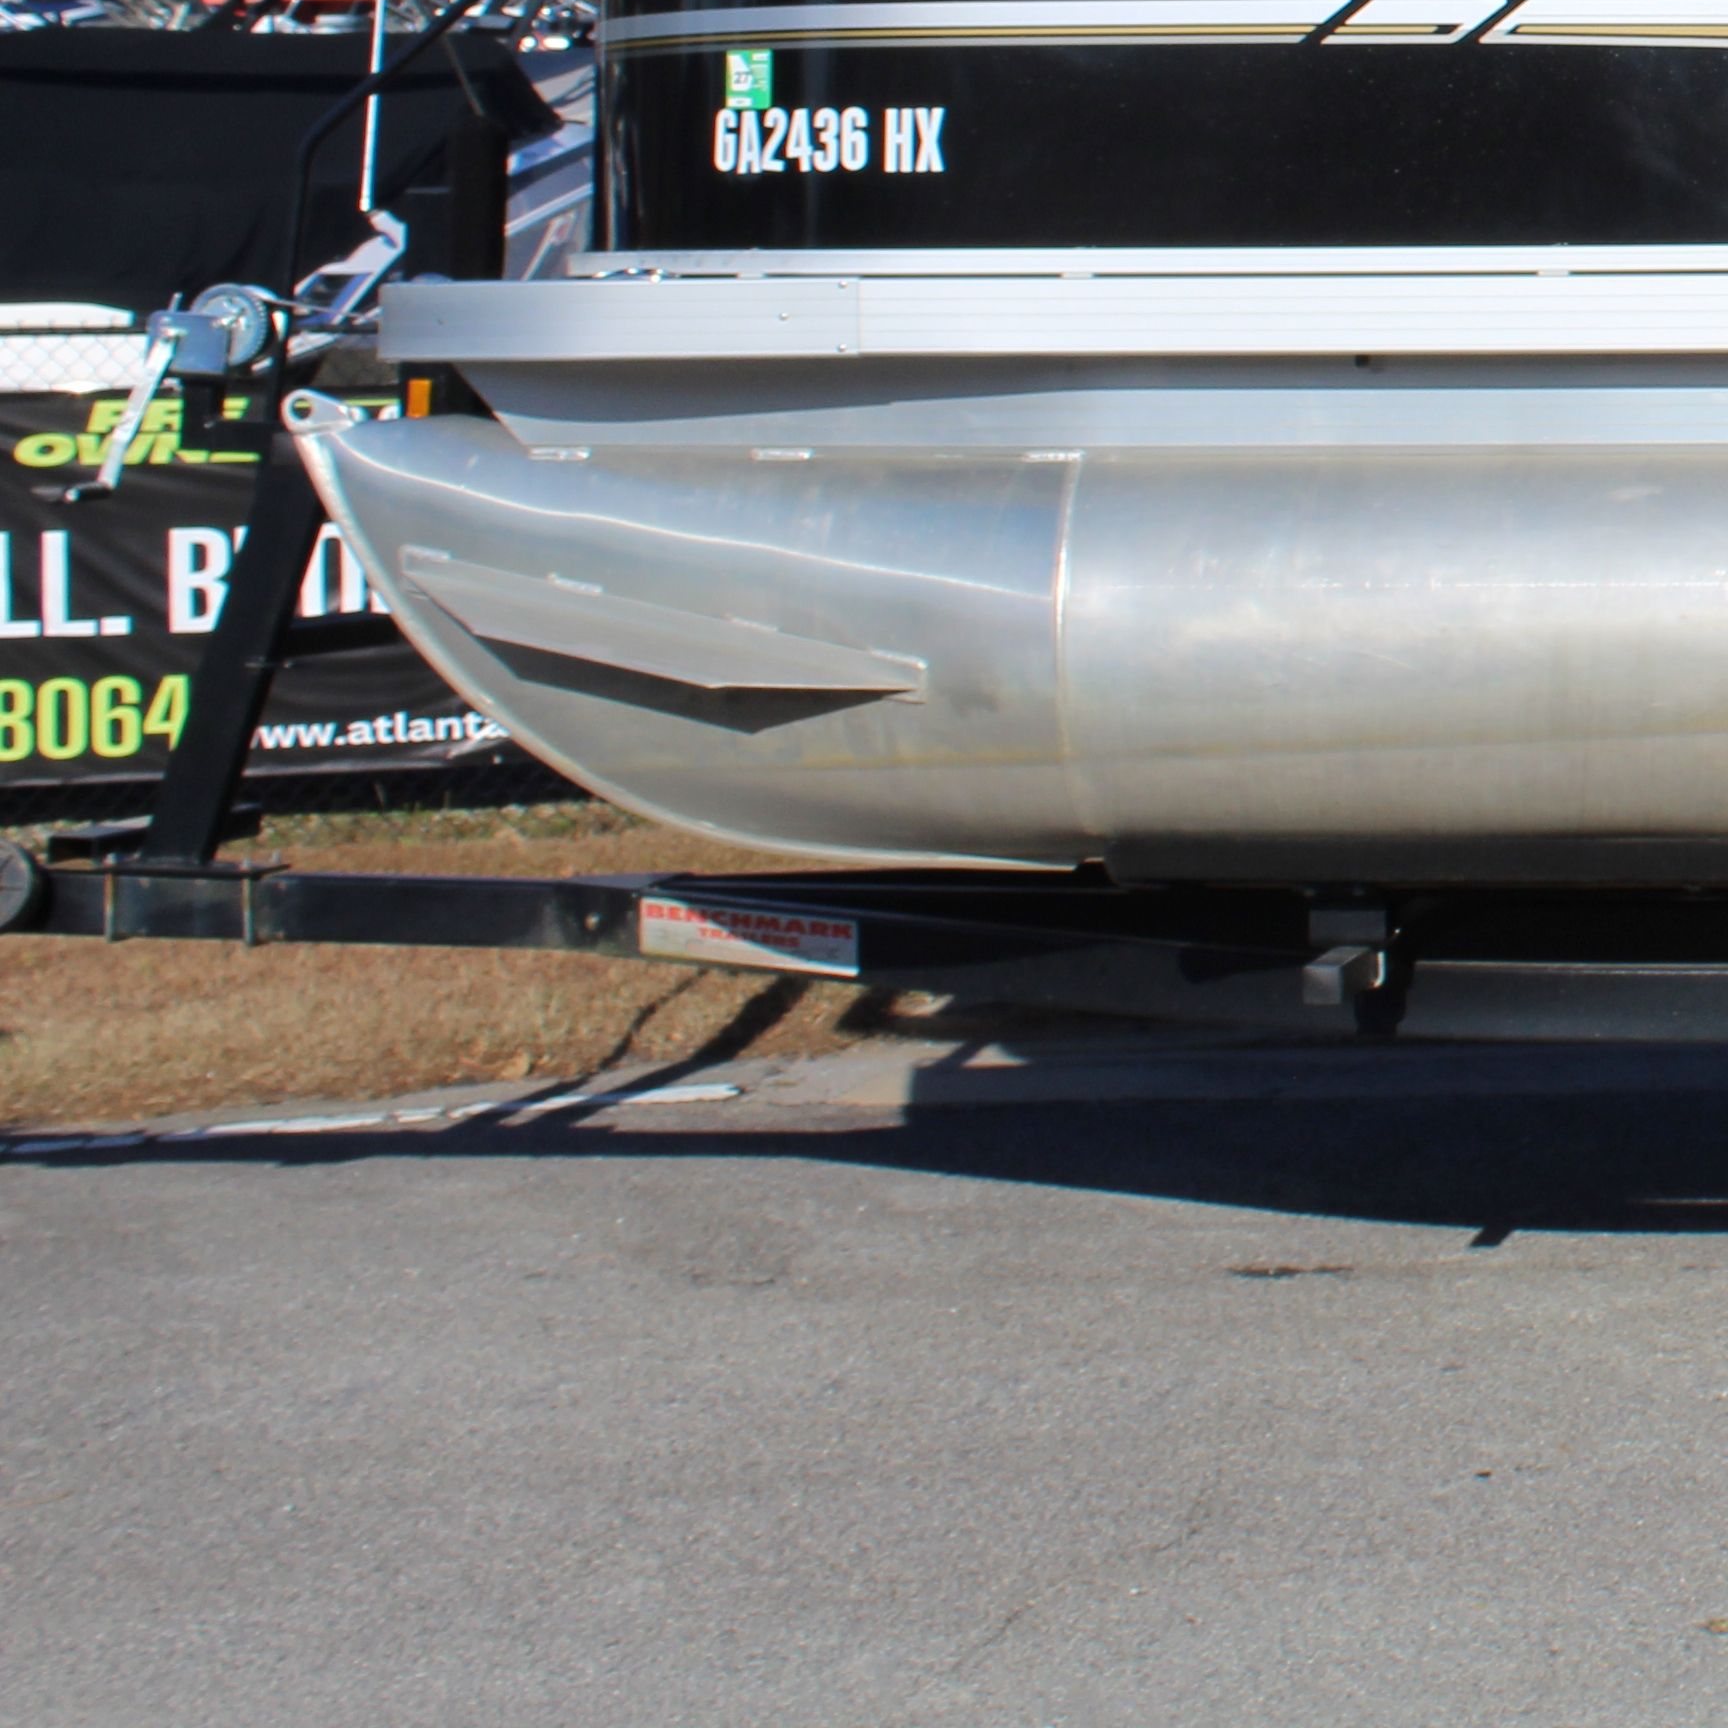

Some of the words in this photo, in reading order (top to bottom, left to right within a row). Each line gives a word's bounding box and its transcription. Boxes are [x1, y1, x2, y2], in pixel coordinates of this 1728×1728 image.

[713, 106, 869, 174] GA2436
[884, 107, 946, 173] HX
[645, 902, 853, 940] BENCHMARK
